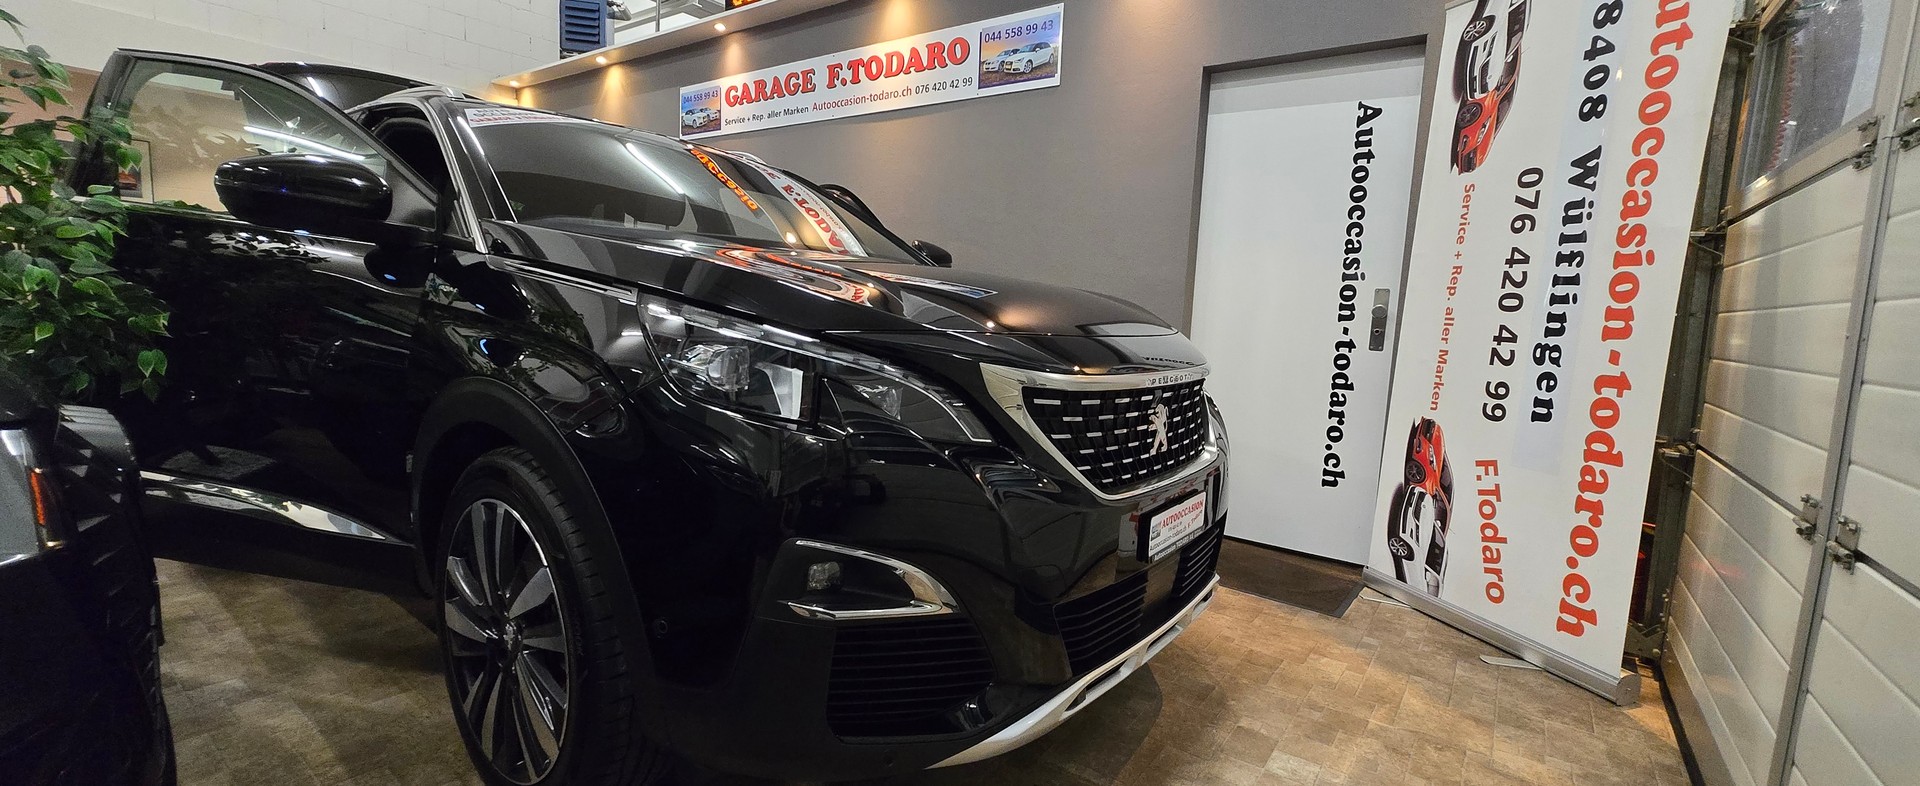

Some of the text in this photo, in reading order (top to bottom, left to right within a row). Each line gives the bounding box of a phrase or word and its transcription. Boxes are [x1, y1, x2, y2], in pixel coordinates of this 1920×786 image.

[984, 19, 1054, 44] 044 558 99 43
[693, 93, 703, 102] 558
[703, 91, 711, 100] 99
[711, 90, 719, 98] 43
[724, 116, 746, 126] Service
[752, 113, 766, 123] Rep.
[767, 109, 782, 119] aller
[783, 106, 809, 117] Marken
[811, 86, 912, 112] Autooccasion-todaro.ch
[915, 83, 930, 95] 076
[931, 80, 948, 92] 420
[949, 77, 960, 89] 42
[962, 75, 973, 87] 99
[725, 36, 971, 108] GARAGE F.TODARO
[1456, 183, 1476, 245] Service
[1530, 0, 1624, 424] 8408 Wülflingen
[1321, 101, 1383, 489] Autooccasion-todaro.ch
[1446, 265, 1463, 301] Rep.
[1481, 166, 1544, 423] 076 420 42 99
[1440, 306, 1455, 344] aller
[1555, 0, 1694, 638] utooccasion-todaro.ch
[1150, 373, 1188, 387] PEUGEOT
[1429, 349, 1449, 411] Marken
[1474, 458, 1509, 606] F.Todaro
